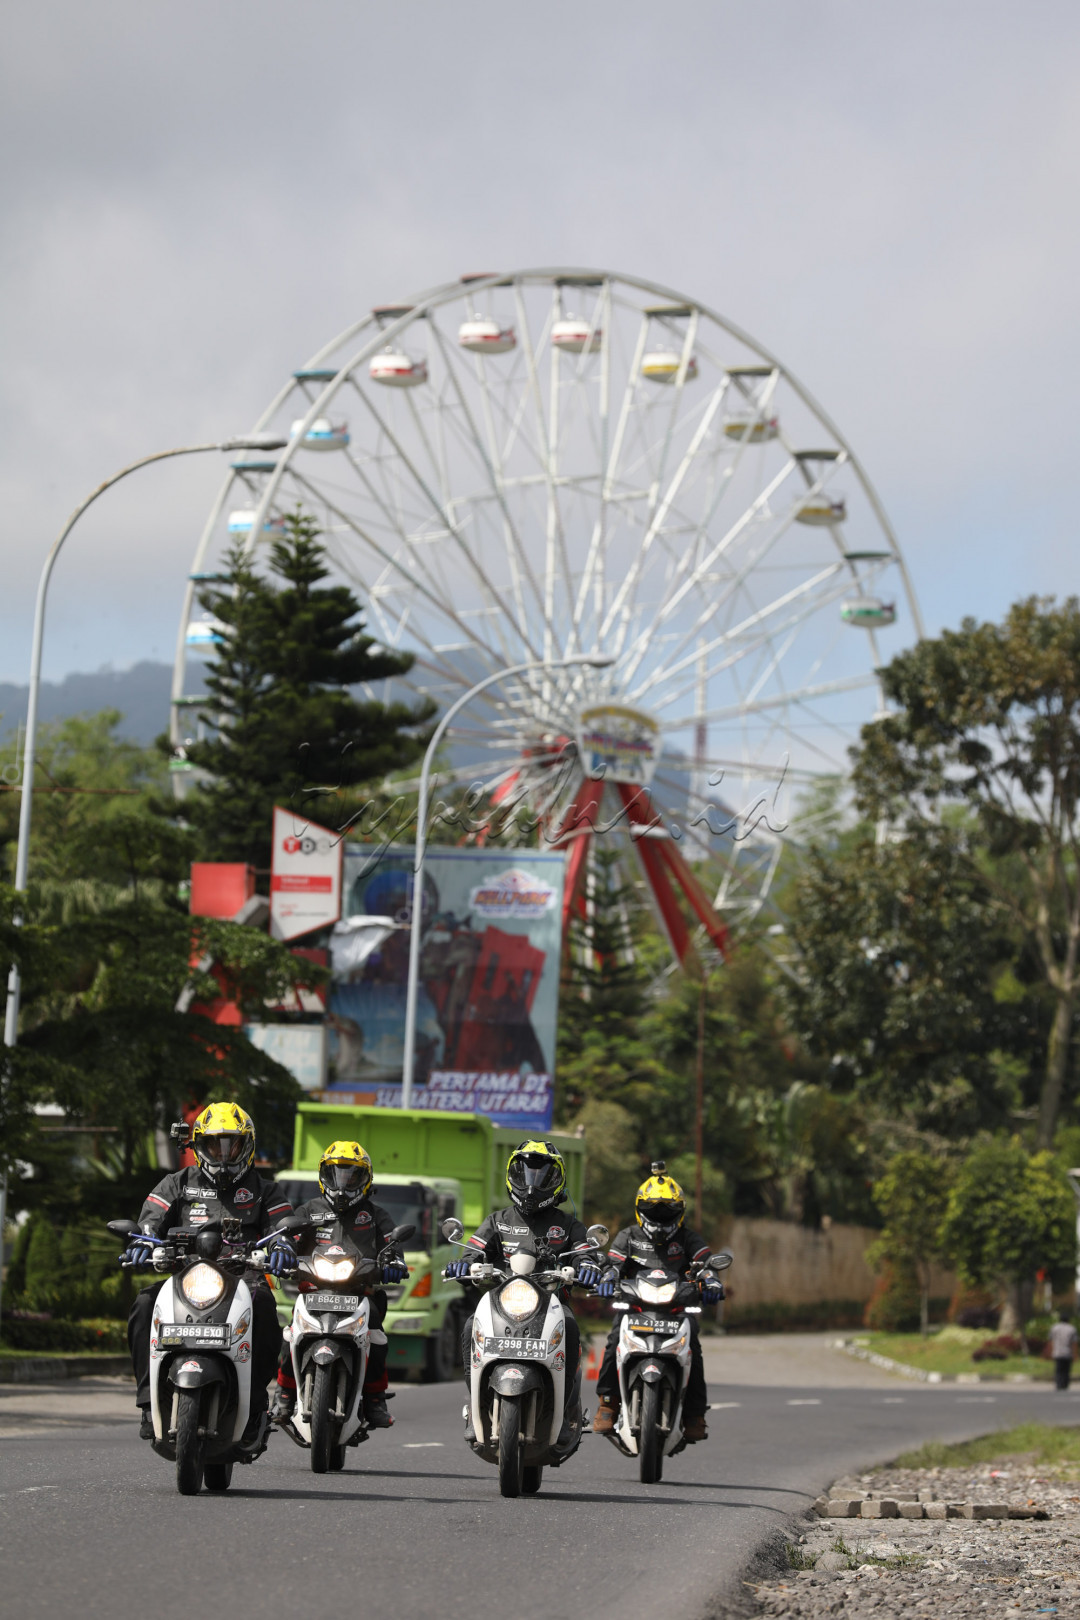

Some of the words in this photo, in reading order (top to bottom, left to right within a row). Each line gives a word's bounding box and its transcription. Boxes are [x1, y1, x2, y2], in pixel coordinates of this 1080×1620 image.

[430, 1071, 520, 1092] PERTAMA
[524, 1073, 549, 1093] DI
[375, 1087, 476, 1113] SUATERA
[163, 1327, 171, 1337] B
[176, 1327, 202, 1337] 3869
[498, 1339, 522, 1349] 2998
[525, 1341, 546, 1351] FAN
